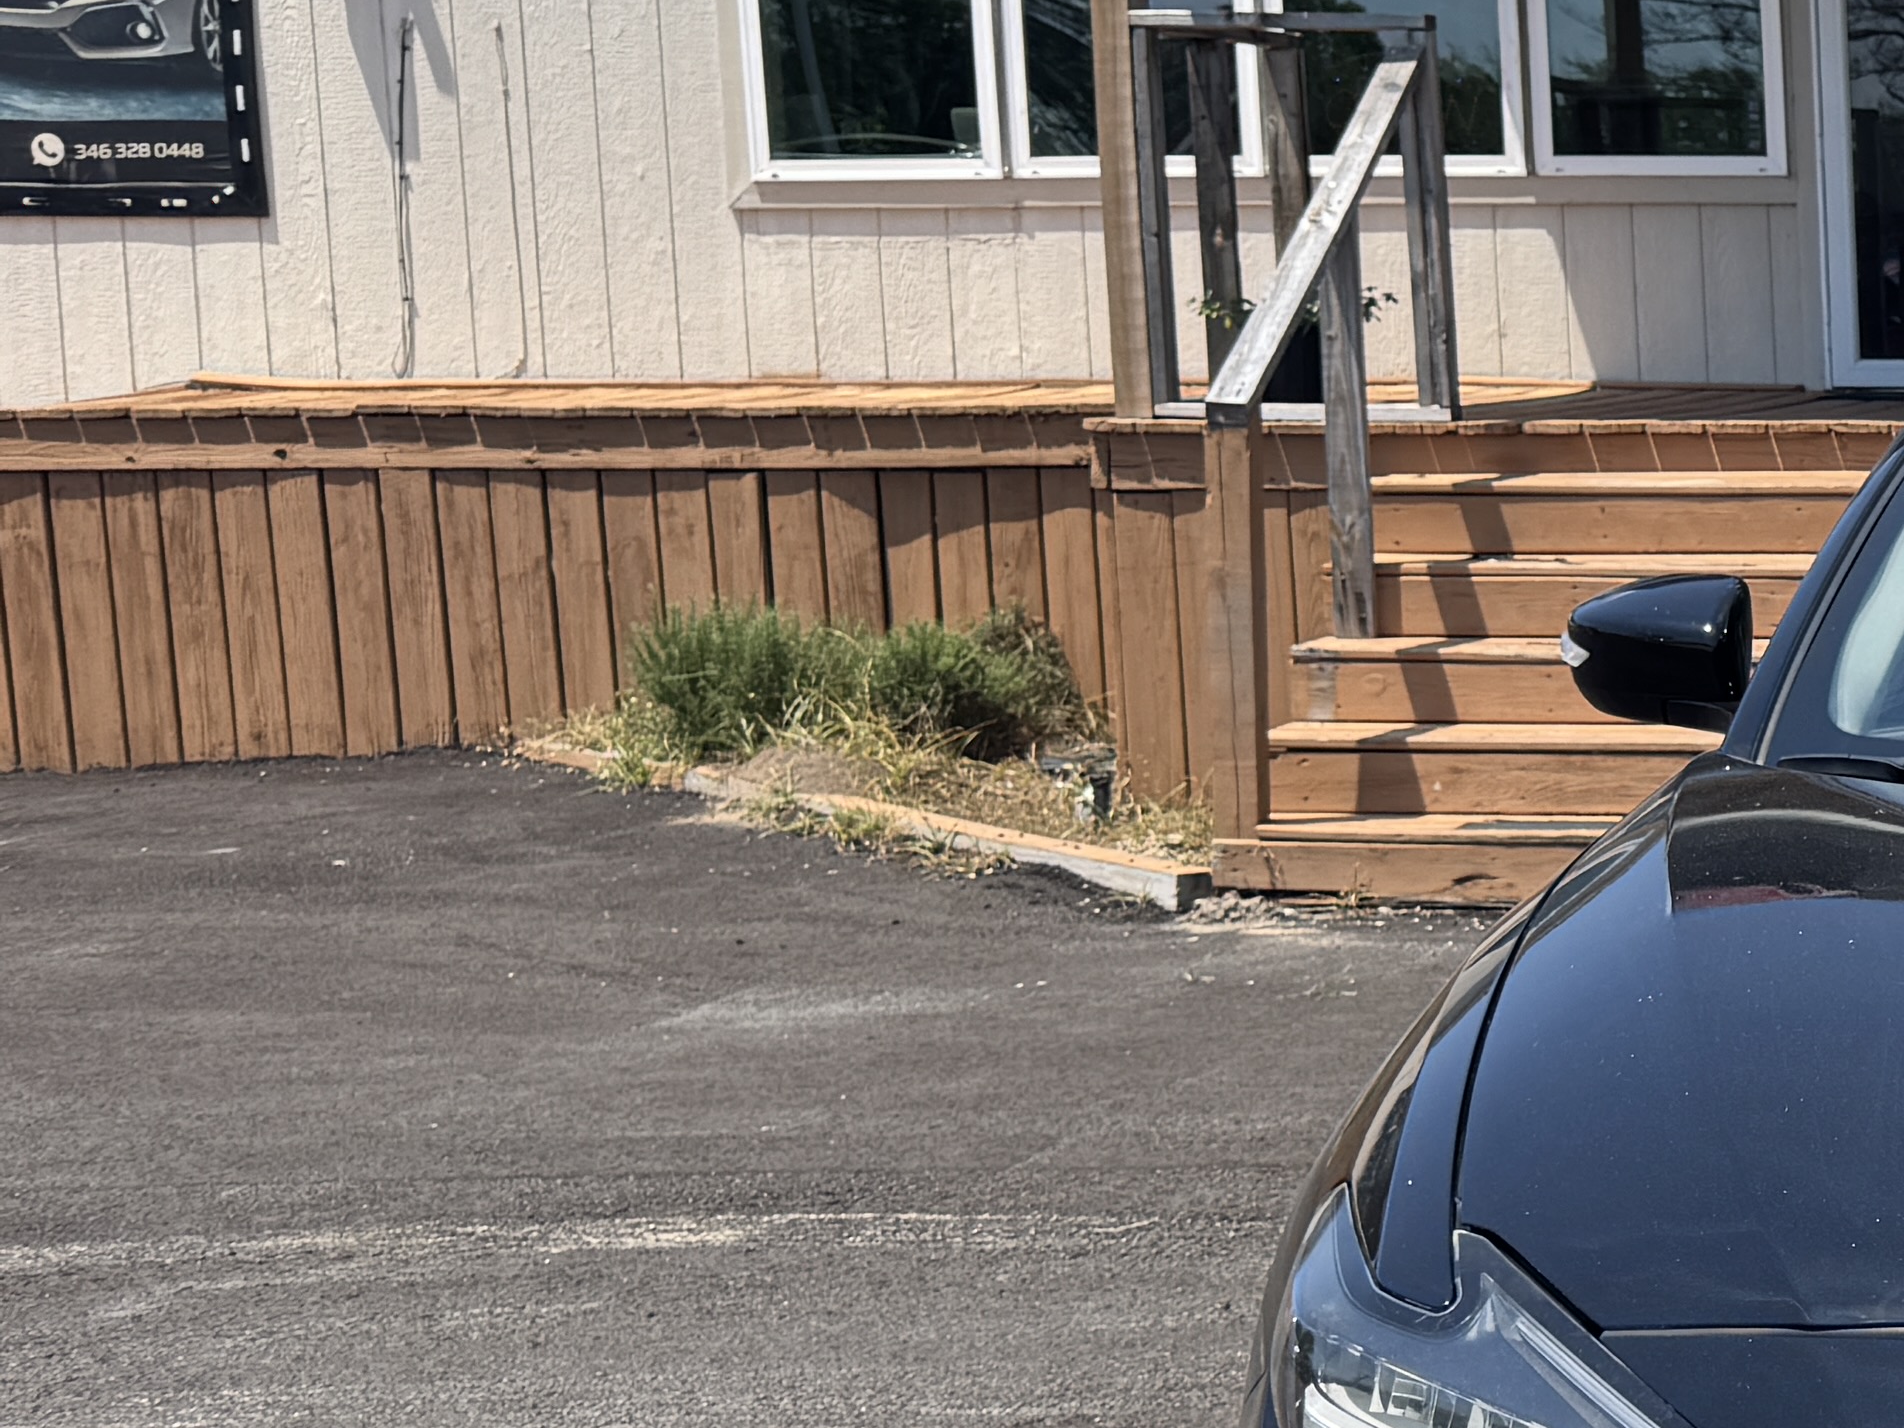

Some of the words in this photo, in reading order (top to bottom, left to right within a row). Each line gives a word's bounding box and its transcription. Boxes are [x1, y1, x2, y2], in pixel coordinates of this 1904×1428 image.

[73, 143, 112, 160] 346
[114, 142, 151, 159] 328
[153, 142, 204, 159] 0448
